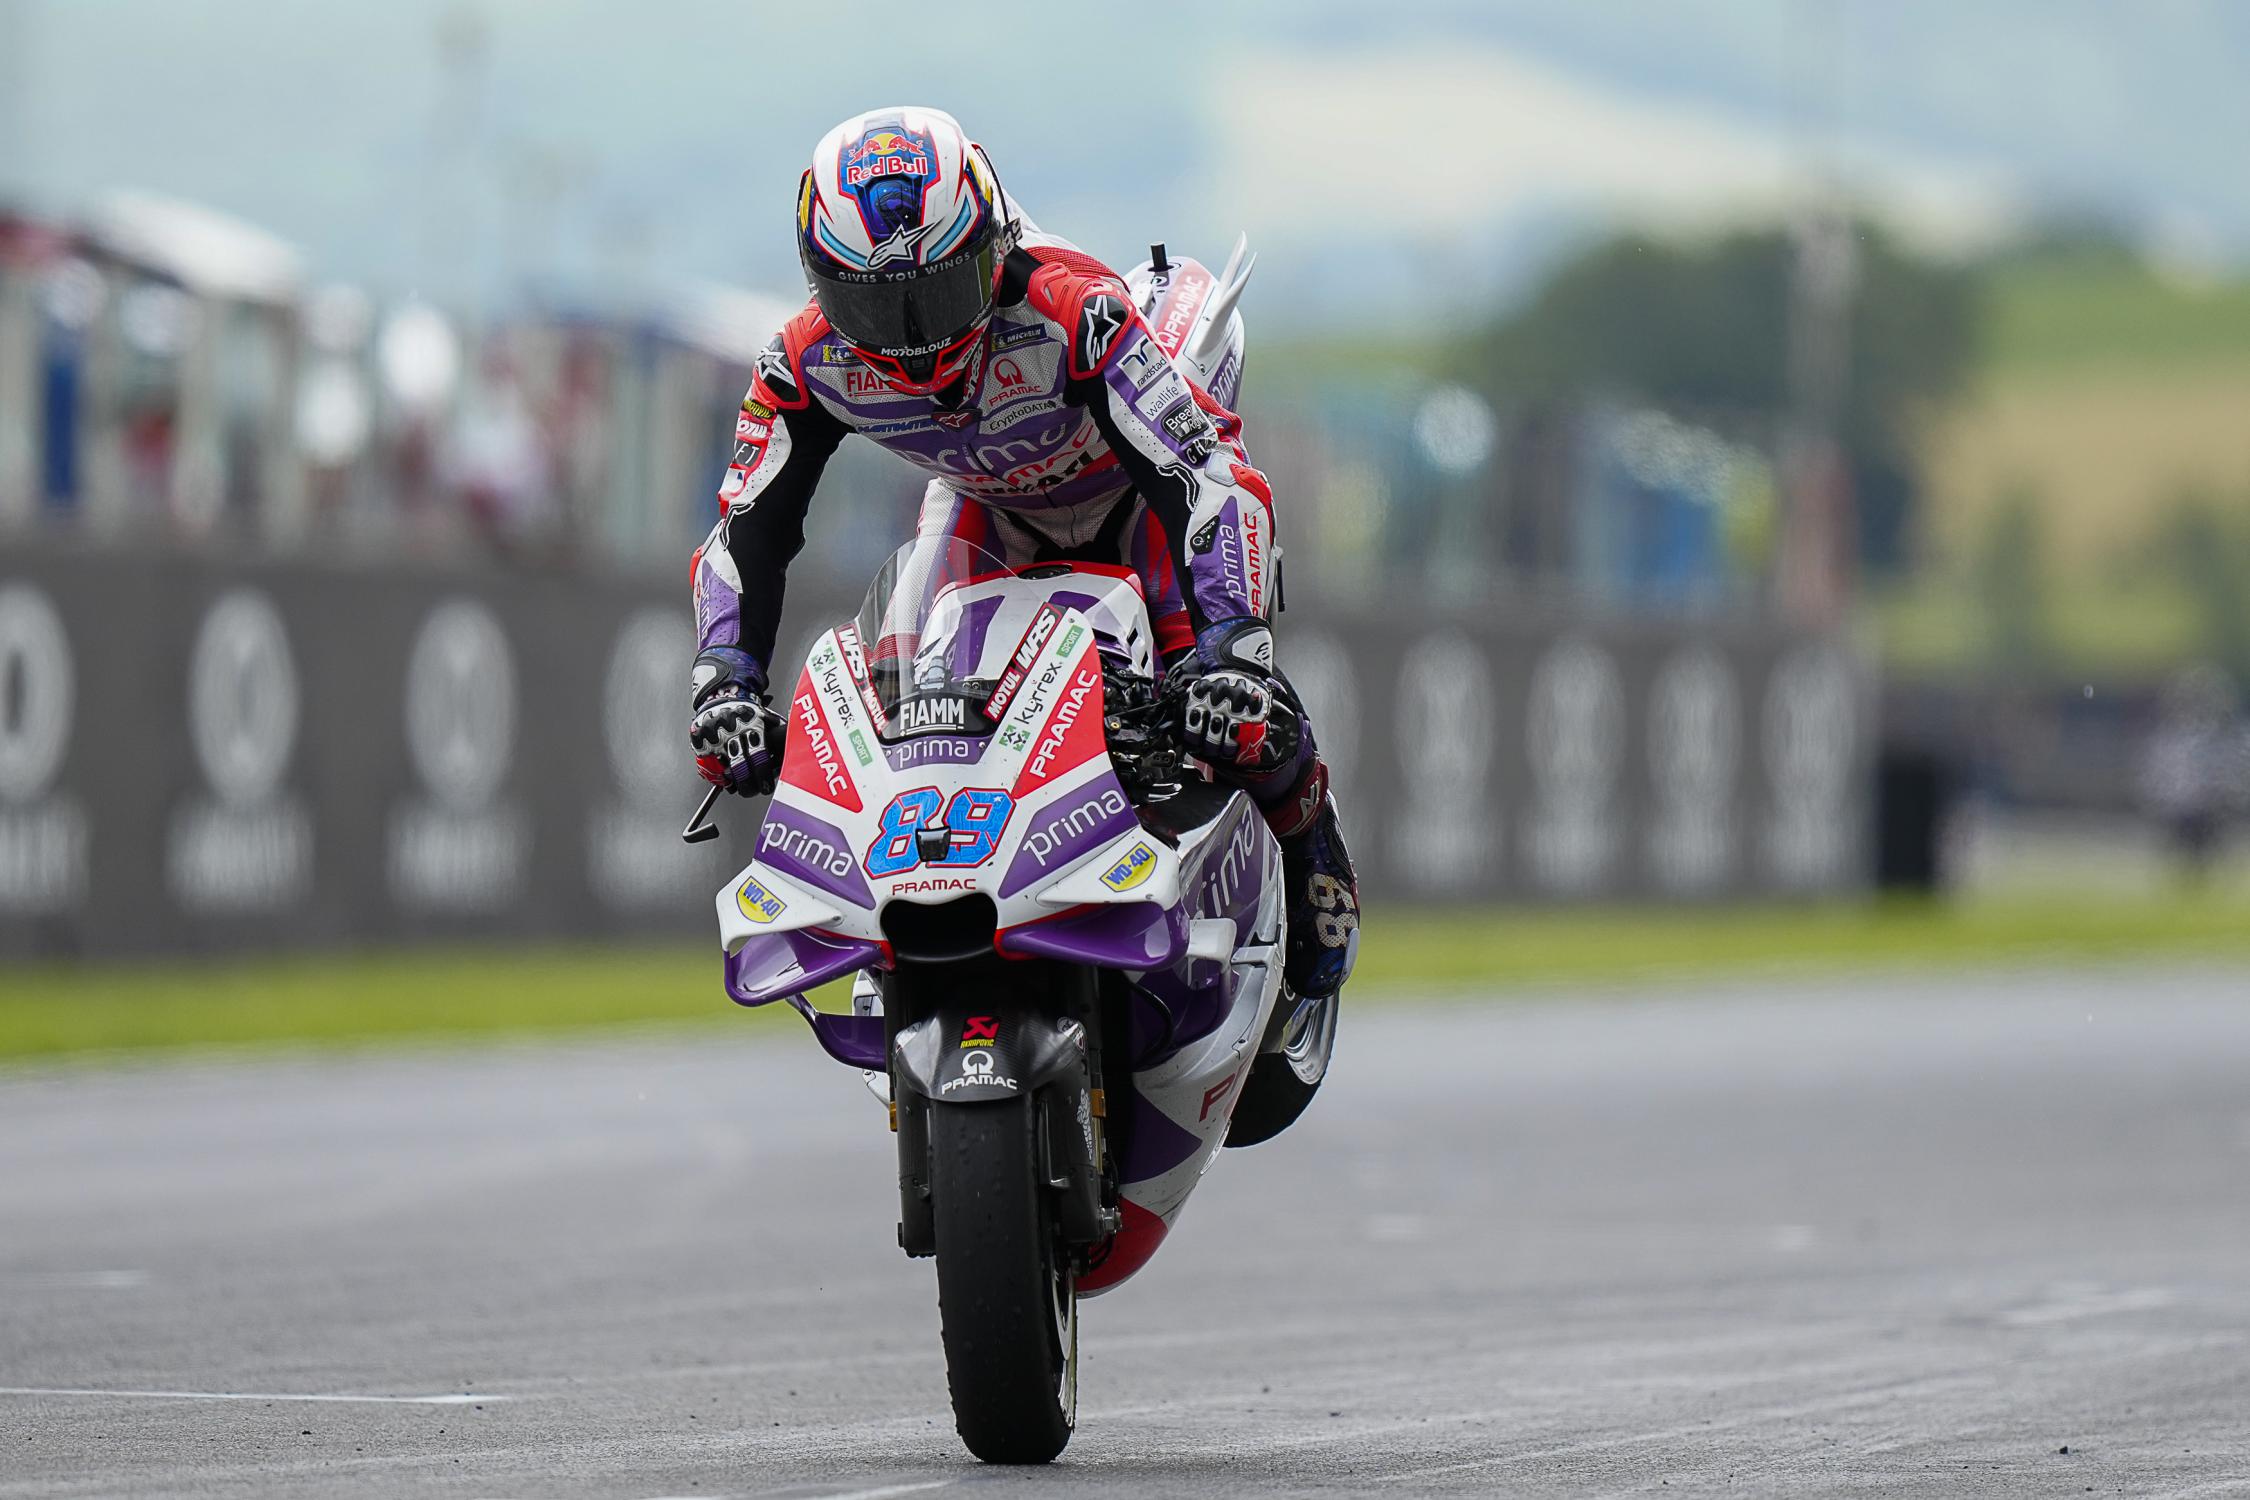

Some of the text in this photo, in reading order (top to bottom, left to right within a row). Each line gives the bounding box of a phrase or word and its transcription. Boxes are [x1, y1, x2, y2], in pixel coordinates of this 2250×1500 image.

[847, 157, 928, 184] Red Bull
[838, 252, 972, 283] GIVES YOU WINGS
[1166, 276, 1204, 342] PRAMAC
[881, 336, 952, 357] MOTOBLOUZ
[1137, 356, 1168, 387] randstad
[988, 384, 1043, 407] PRAMAC
[1146, 386, 1179, 418] wallife
[989, 401, 1055, 431] CryptoDATA
[1219, 524, 1247, 599] prima
[1017, 608, 1057, 671] WRS
[1061, 629, 1081, 656] SPORT
[987, 672, 1021, 719] MOTUL
[1014, 663, 1062, 724] kyrrex
[900, 698, 965, 730] FIAMM
[1030, 669, 1098, 778] PRAMAC
[795, 693, 847, 796] PRAMAC
[851, 734, 869, 761] SPORT
[896, 739, 969, 768] prima
[863, 786, 1016, 880] 89
[1022, 788, 1126, 867] prima
[761, 822, 853, 877] prima
[1106, 849, 1152, 886] WD-40
[743, 881, 780, 917] WD-40
[892, 878, 977, 895] PRAMAC
[941, 1074, 1018, 1095] PRAMAC
